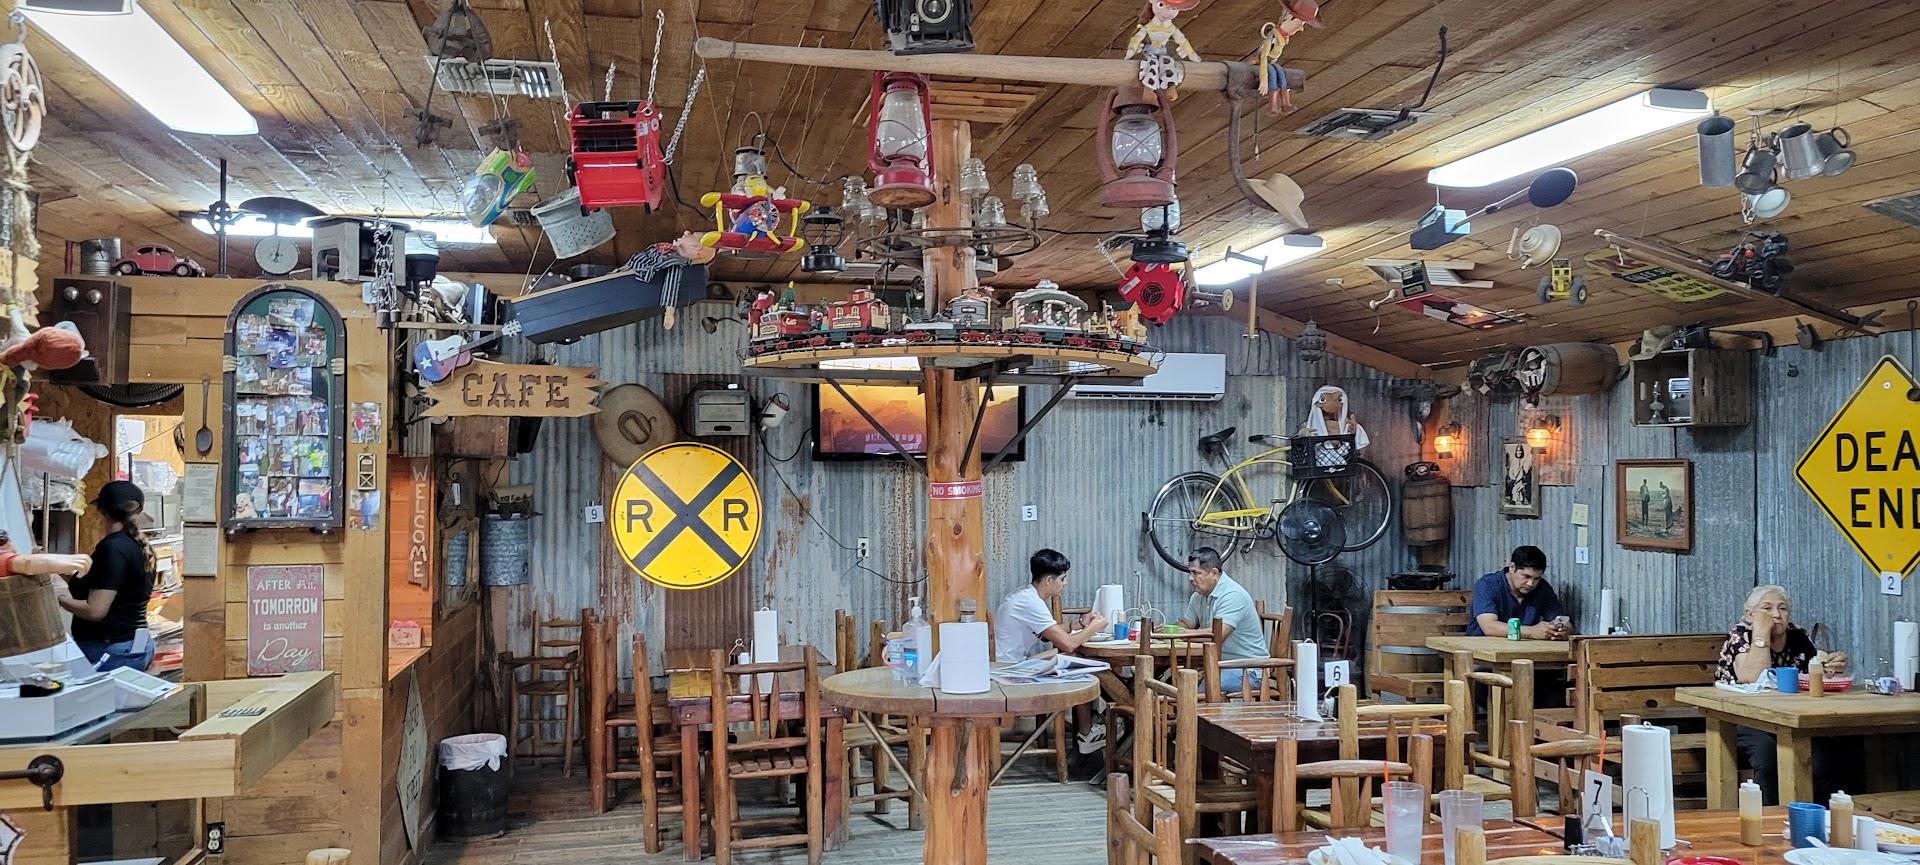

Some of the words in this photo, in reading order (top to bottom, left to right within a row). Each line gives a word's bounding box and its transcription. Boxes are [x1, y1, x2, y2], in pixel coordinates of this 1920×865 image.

[461, 372, 570, 408] CAFE
[932, 486, 945, 496] NO
[947, 485, 981, 496] SMOKING
[591, 508, 598, 520] 9
[626, 499, 654, 533] R
[723, 498, 749, 532] R
[1026, 507, 1033, 518] 5
[410, 464, 429, 578] WELCOME
[1580, 550, 1585, 561] 1
[256, 580, 292, 591] AFTER
[1887, 575, 1895, 590] 2
[253, 597, 318, 615] TOMORROW
[263, 621, 272, 631] is
[273, 620, 308, 631] another
[256, 637, 313, 666] Day
[1333, 665, 1341, 681] 6
[1593, 779, 1603, 805] 7
